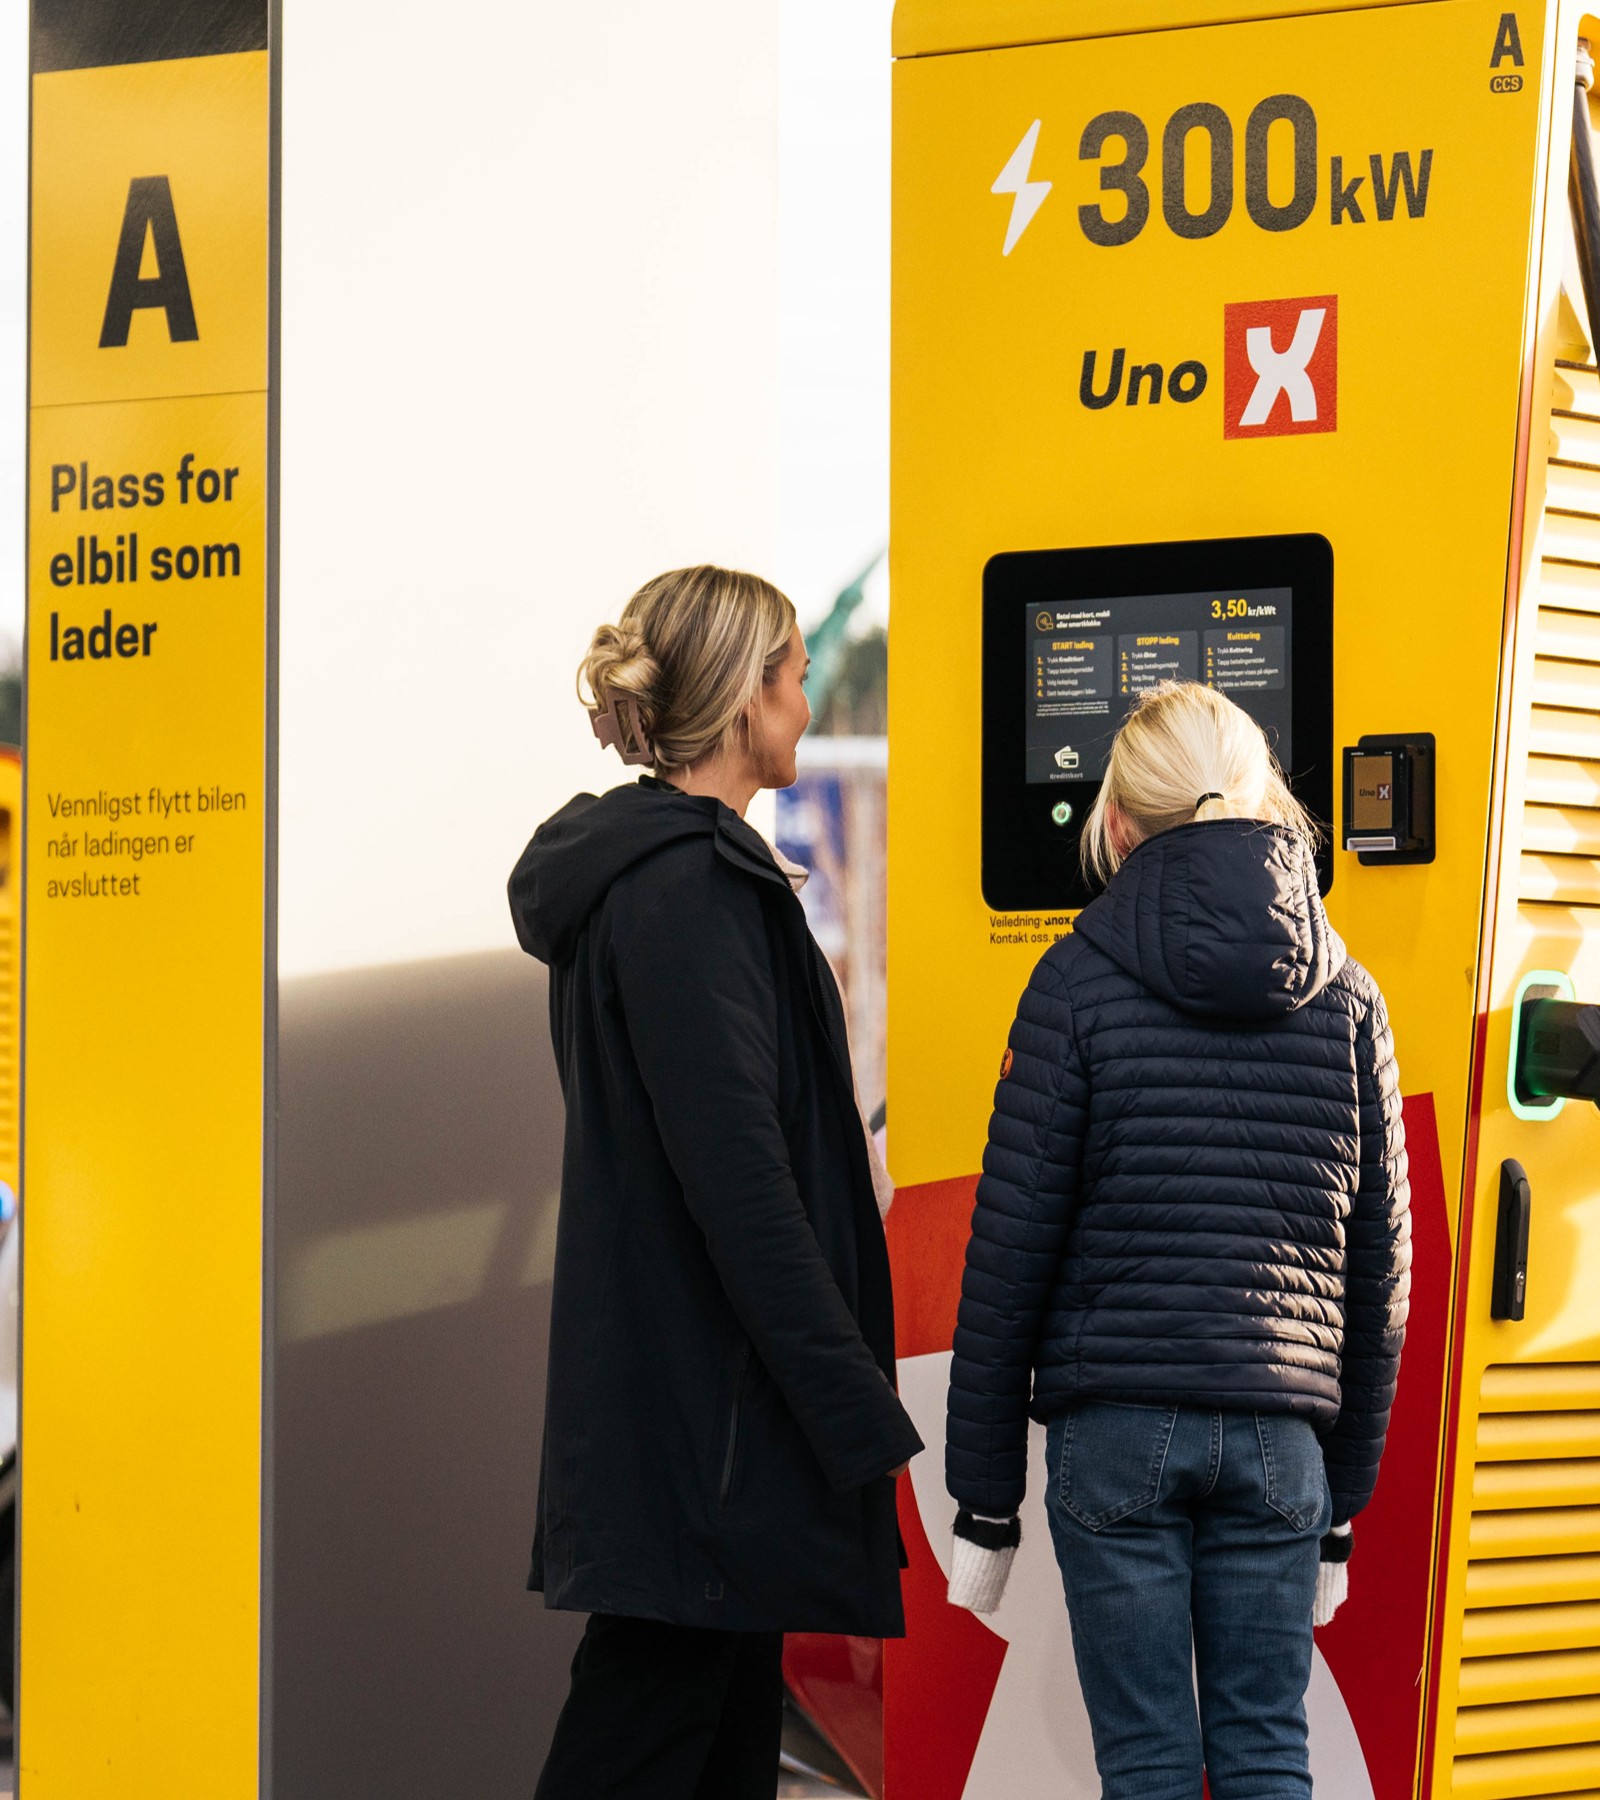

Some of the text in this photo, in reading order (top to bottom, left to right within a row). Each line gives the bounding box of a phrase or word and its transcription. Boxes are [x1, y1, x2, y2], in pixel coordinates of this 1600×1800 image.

[1490, 13, 1524, 68] A
[1494, 77, 1520, 92] CCS
[98, 175, 200, 348] A
[1078, 308, 1327, 426] Uno X
[51, 453, 239, 512] Plass for
[50, 533, 241, 587] elbil som
[50, 609, 158, 661] lader
[1137, 636, 1179, 646] STOPP lading
[1227, 632, 1261, 641] Kvittering
[1122, 652, 1128, 660] 1.
[1207, 647, 1213, 655] 1.
[1122, 663, 1128, 671] 2.
[1207, 658, 1213, 666] 2.
[1122, 685, 1128, 693] 4.
[1050, 772, 1083, 780] Kredittkort
[48, 786, 247, 822] Vennligst flytt bilen
[47, 831, 196, 861] når ladingen er
[47, 872, 141, 898] avsluttet
[989, 932, 1029, 944] Kontakt
